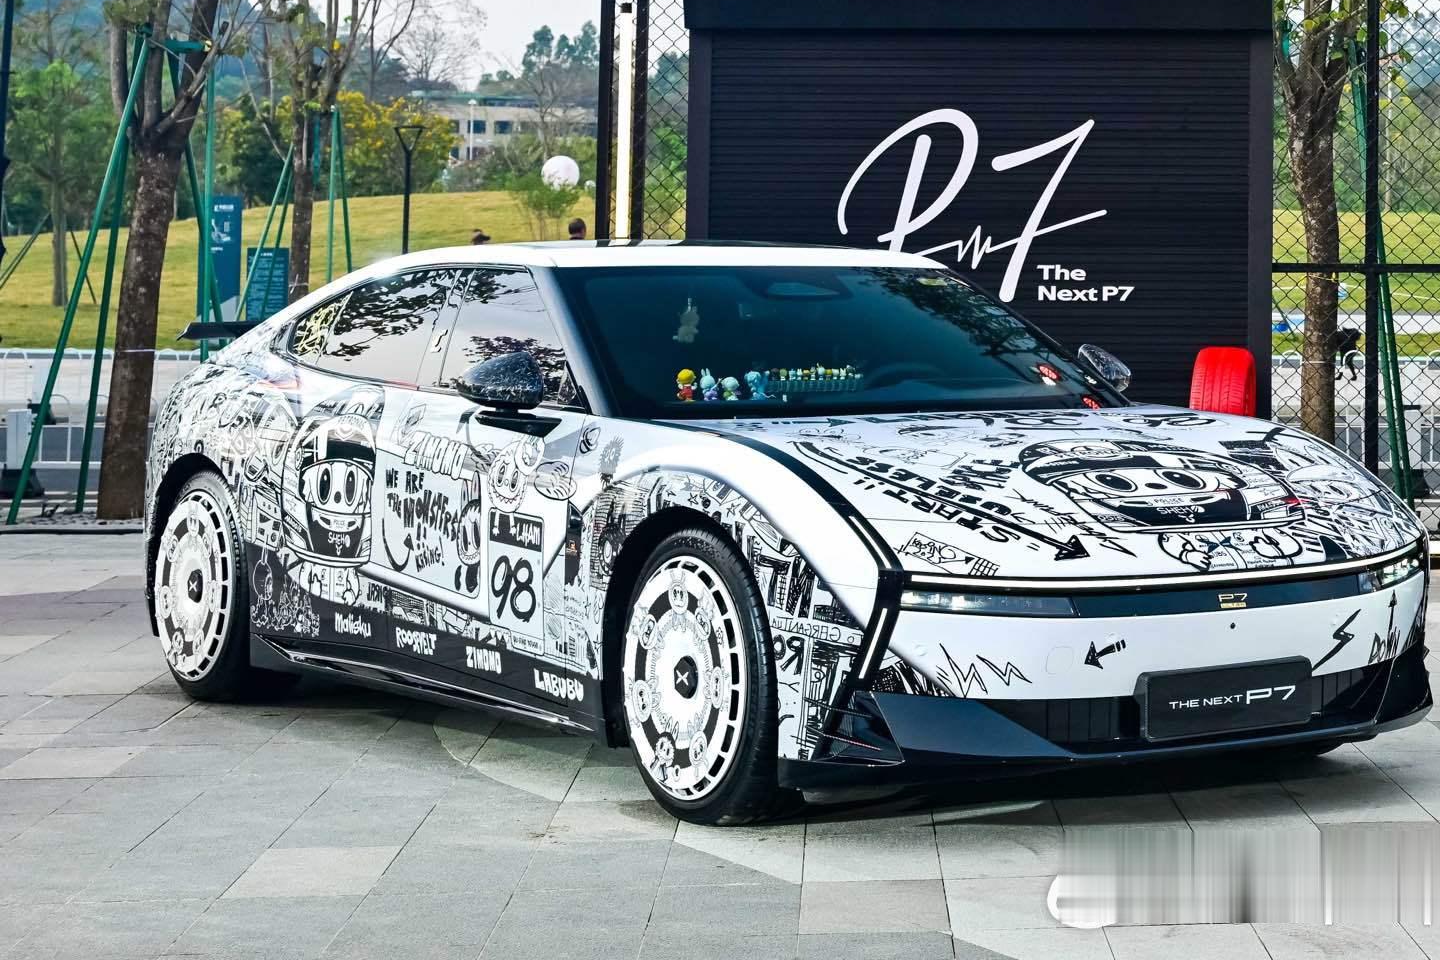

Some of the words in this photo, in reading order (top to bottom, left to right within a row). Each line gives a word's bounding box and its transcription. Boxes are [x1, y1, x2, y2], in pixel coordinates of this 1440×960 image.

[1037, 265, 1087, 281] The
[1038, 286, 1098, 302] Next
[1102, 286, 1135, 302] P7
[386, 467, 399, 488] WE
[406, 470, 425, 492] ARE
[491, 555, 537, 623] 98
[1218, 593, 1248, 602] P7
[465, 645, 502, 674] ZIMOMO
[533, 668, 584, 702] LABUBU
[1168, 698, 1200, 710] THE
[1203, 694, 1243, 706] NEXT
[1246, 685, 1296, 705] P7
